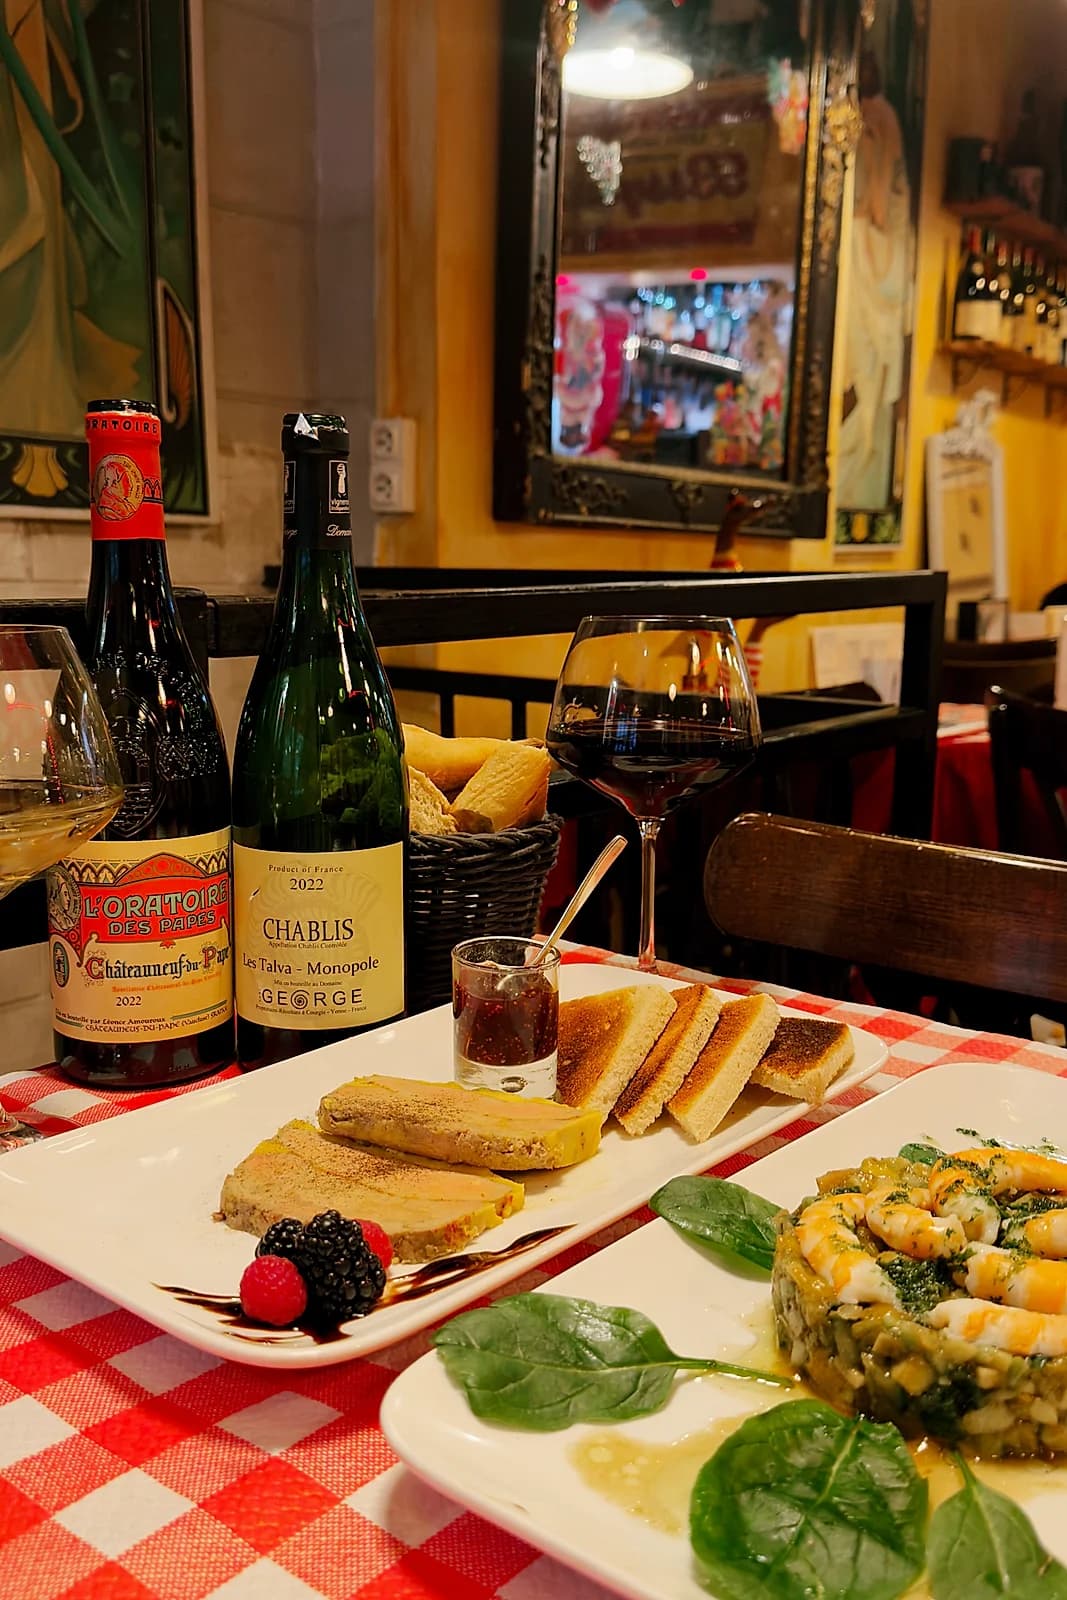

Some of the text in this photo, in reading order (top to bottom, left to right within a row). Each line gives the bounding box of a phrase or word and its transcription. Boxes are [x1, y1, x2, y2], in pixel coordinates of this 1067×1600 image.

[268, 864, 298, 873] Product
[289, 878, 324, 891] 2022
[84, 879, 228, 918] L'ORATOIRE
[109, 910, 215, 935] DES PAPES
[263, 918, 354, 942] CHABLIS
[243, 953, 257, 969] Les
[259, 958, 292, 975] Talva
[307, 956, 379, 976] Monopole
[116, 996, 142, 1007] 2022
[262, 988, 363, 1010] GEORGE
[90, 1018, 101, 1026] par
[128, 1017, 166, 1025] Amouroux
